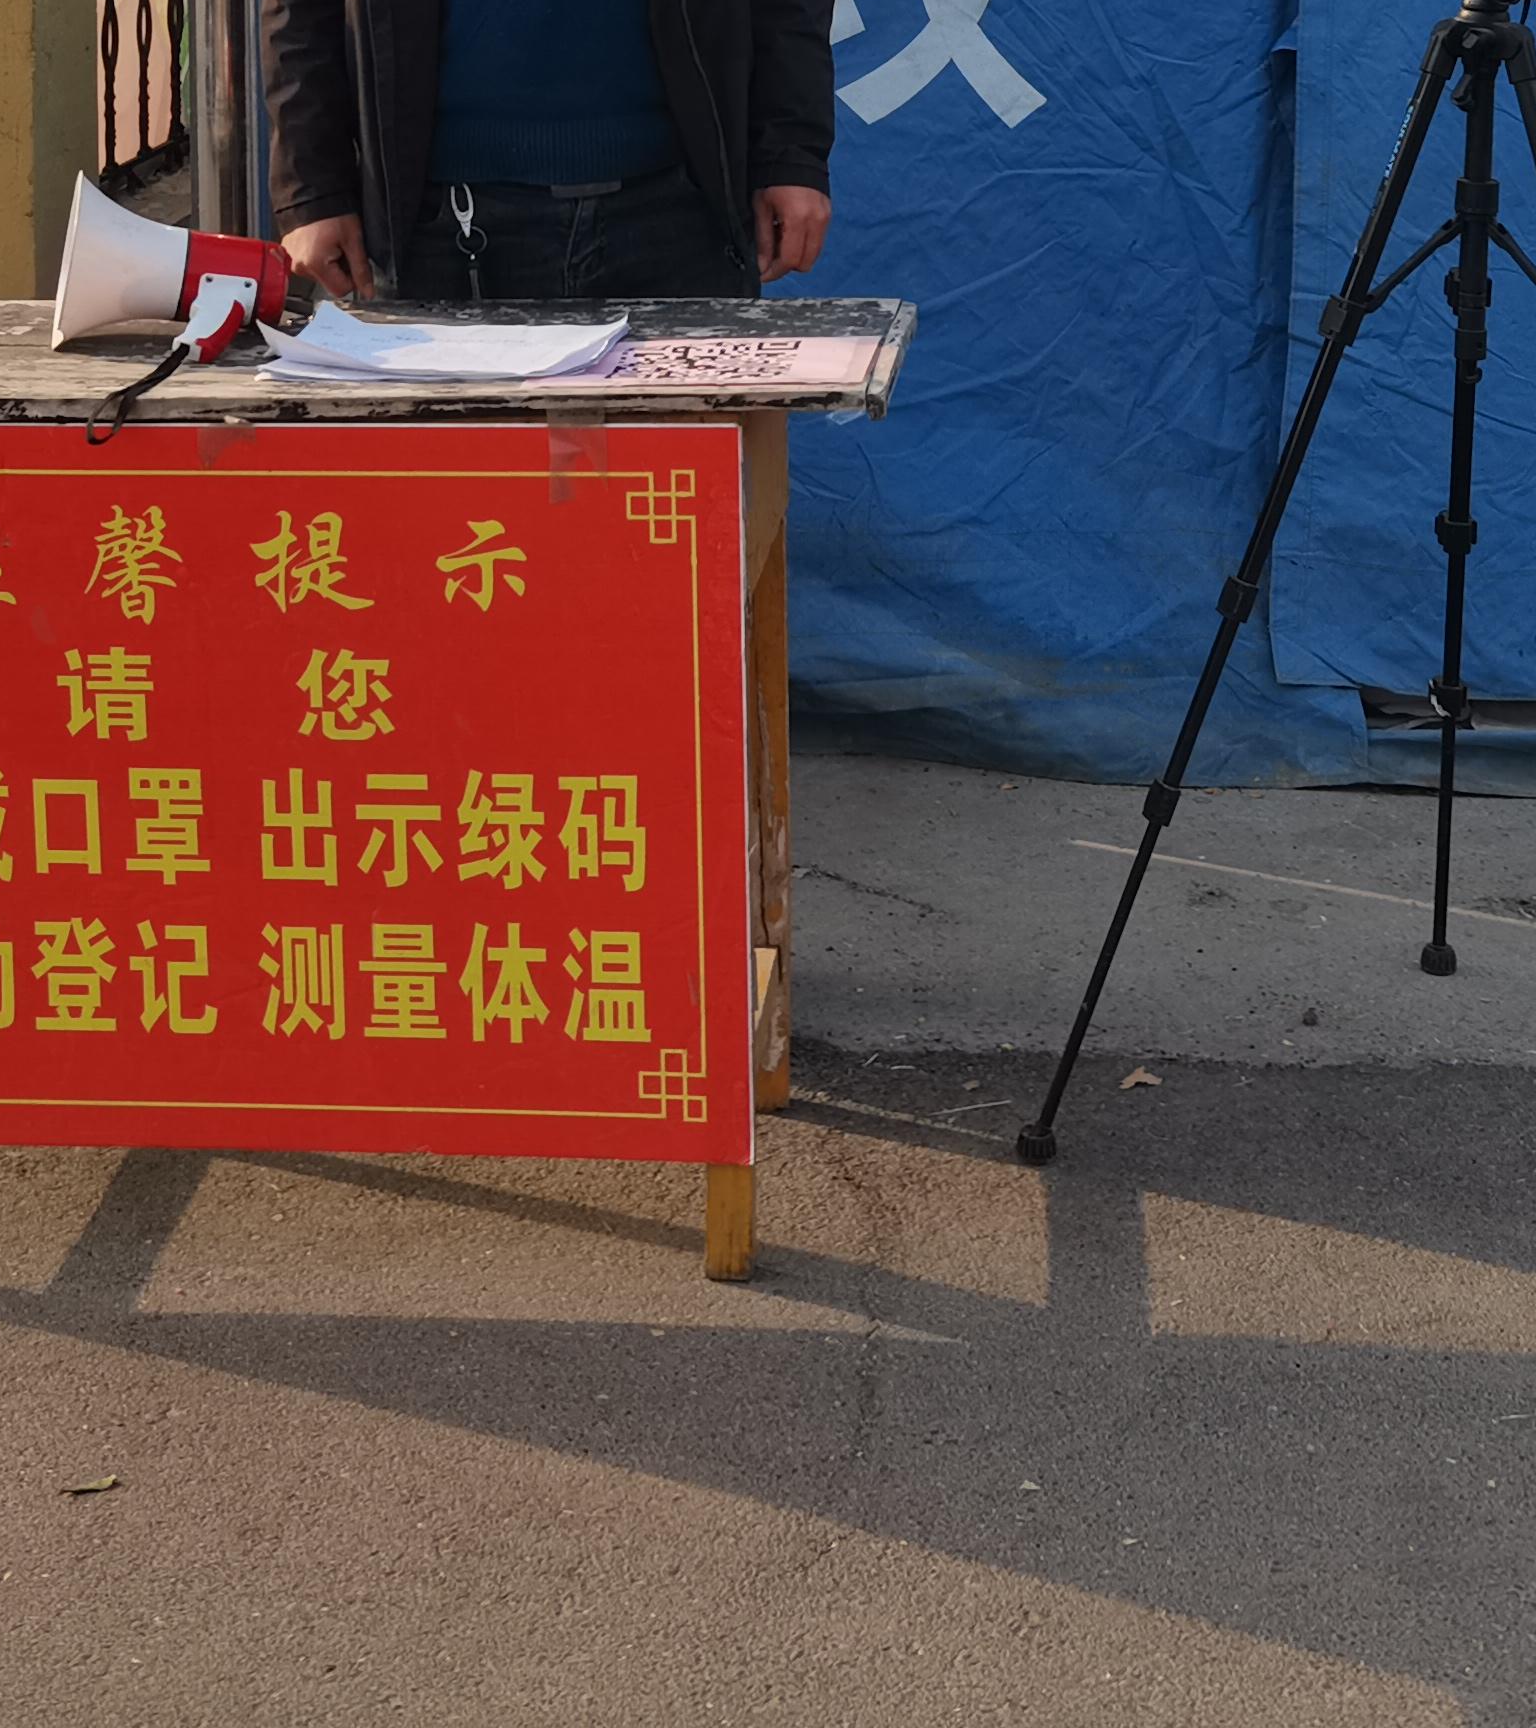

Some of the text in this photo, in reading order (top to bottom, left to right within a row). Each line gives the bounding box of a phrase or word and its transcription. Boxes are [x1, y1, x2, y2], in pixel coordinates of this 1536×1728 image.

[57, 646, 395, 742] 请您
[260, 768, 649, 893] 出示绿码
[259, 922, 652, 1045] 测量体温
